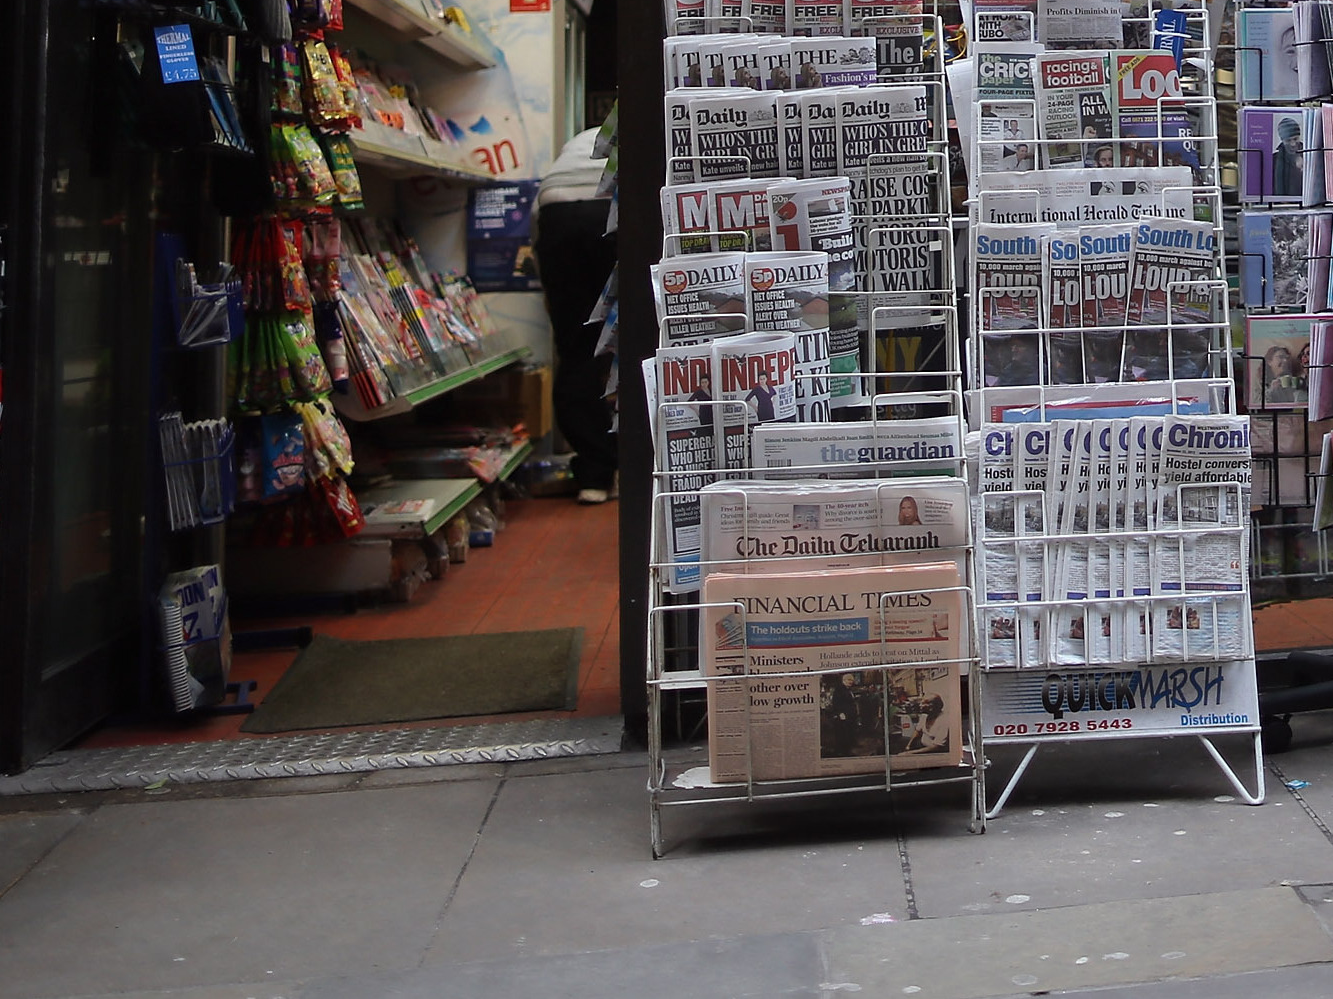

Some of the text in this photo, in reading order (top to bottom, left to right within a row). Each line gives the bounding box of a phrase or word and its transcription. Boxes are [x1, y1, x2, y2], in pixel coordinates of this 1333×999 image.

[794, 5, 837, 17] FREE
[851, 6, 894, 17] FREE
[1046, 6, 1108, 16] Profits Diminish
[875, 26, 920, 35] EXCLUSIVE
[156, 32, 191, 44] THERMAL
[165, 43, 187, 51] LINED
[877, 38, 914, 64] The
[794, 49, 838, 65] THE
[164, 68, 197, 81] £4.75
[825, 72, 869, 83] Fashion's
[1046, 71, 1099, 86] football
[1047, 100, 1074, 108] 24-PAGE
[1081, 95, 1103, 106] ALL
[841, 100, 890, 118] Daily
[1048, 106, 1075, 114] RACING
[696, 107, 748, 127] Daily
[1045, 112, 1077, 121] OUTLOOK
[844, 120, 918, 140] WHO'S THE
[701, 132, 747, 149] WHO'S
[844, 137, 894, 155] GIRL IN
[702, 163, 743, 176] Kate unveils
[772, 194, 789, 203] 20p
[1083, 204, 1127, 223] Herald
[1137, 224, 1195, 249] South
[977, 235, 1037, 255] South
[1137, 253, 1203, 267] 10,000 march against
[751, 263, 824, 284] 5p DAILY
[978, 263, 1024, 271] 10,000 march
[1083, 263, 1105, 272] 10,000
[664, 263, 738, 286] 5p DAILY
[1134, 263, 1211, 296] LOUD &
[978, 272, 1038, 298] LOUD
[679, 292, 699, 302] OFFICE
[766, 289, 785, 300] OFFICE
[754, 301, 774, 313] ISSUES
[772, 310, 788, 320] OVER
[820, 441, 955, 463] theguardian
[671, 452, 693, 466] WHO
[1165, 456, 1202, 470] Hostel
[672, 474, 713, 492] FRAUD IS
[1164, 471, 1252, 484] yield affordable
[736, 535, 779, 557] The
[781, 535, 836, 557] Daily
[732, 591, 932, 615] FINANCIAL TIMES
[750, 624, 768, 634] The
[769, 623, 810, 634] holdouts
[811, 622, 838, 633] strike
[839, 621, 862, 632] back
[819, 648, 930, 660] Hollande adds Mittal
[750, 655, 805, 667] Ministers
[819, 660, 850, 668] Johnson
[750, 682, 809, 693] other over
[750, 694, 815, 709] low growth
[1180, 713, 1249, 727] Distribution
[993, 718, 1133, 736] 020 7928 5443
